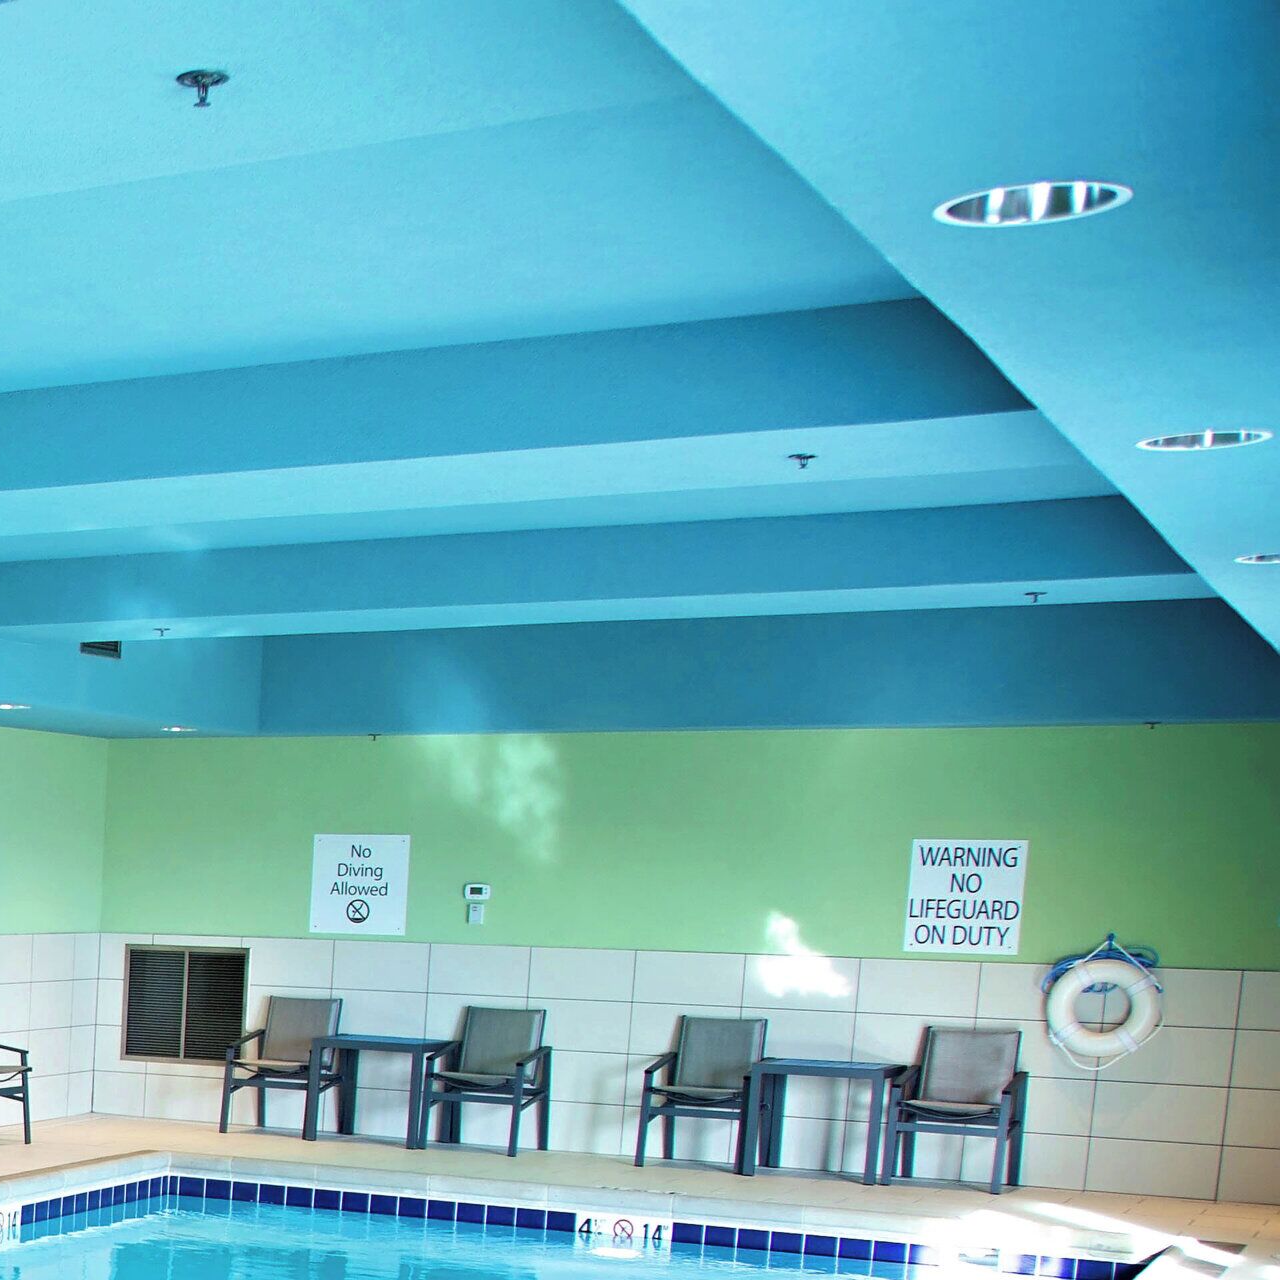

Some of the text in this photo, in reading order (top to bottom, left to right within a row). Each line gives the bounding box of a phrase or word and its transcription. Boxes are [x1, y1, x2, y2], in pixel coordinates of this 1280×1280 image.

[351, 844, 371, 858] No
[920, 846, 1018, 868] WARNING
[337, 863, 383, 881] Diving
[330, 882, 388, 896] Allowed
[950, 873, 983, 893] NO
[909, 898, 1020, 921] LIFEGUARD
[914, 924, 1010, 946] ON DUTY
[578, 1218, 592, 1233] 4
